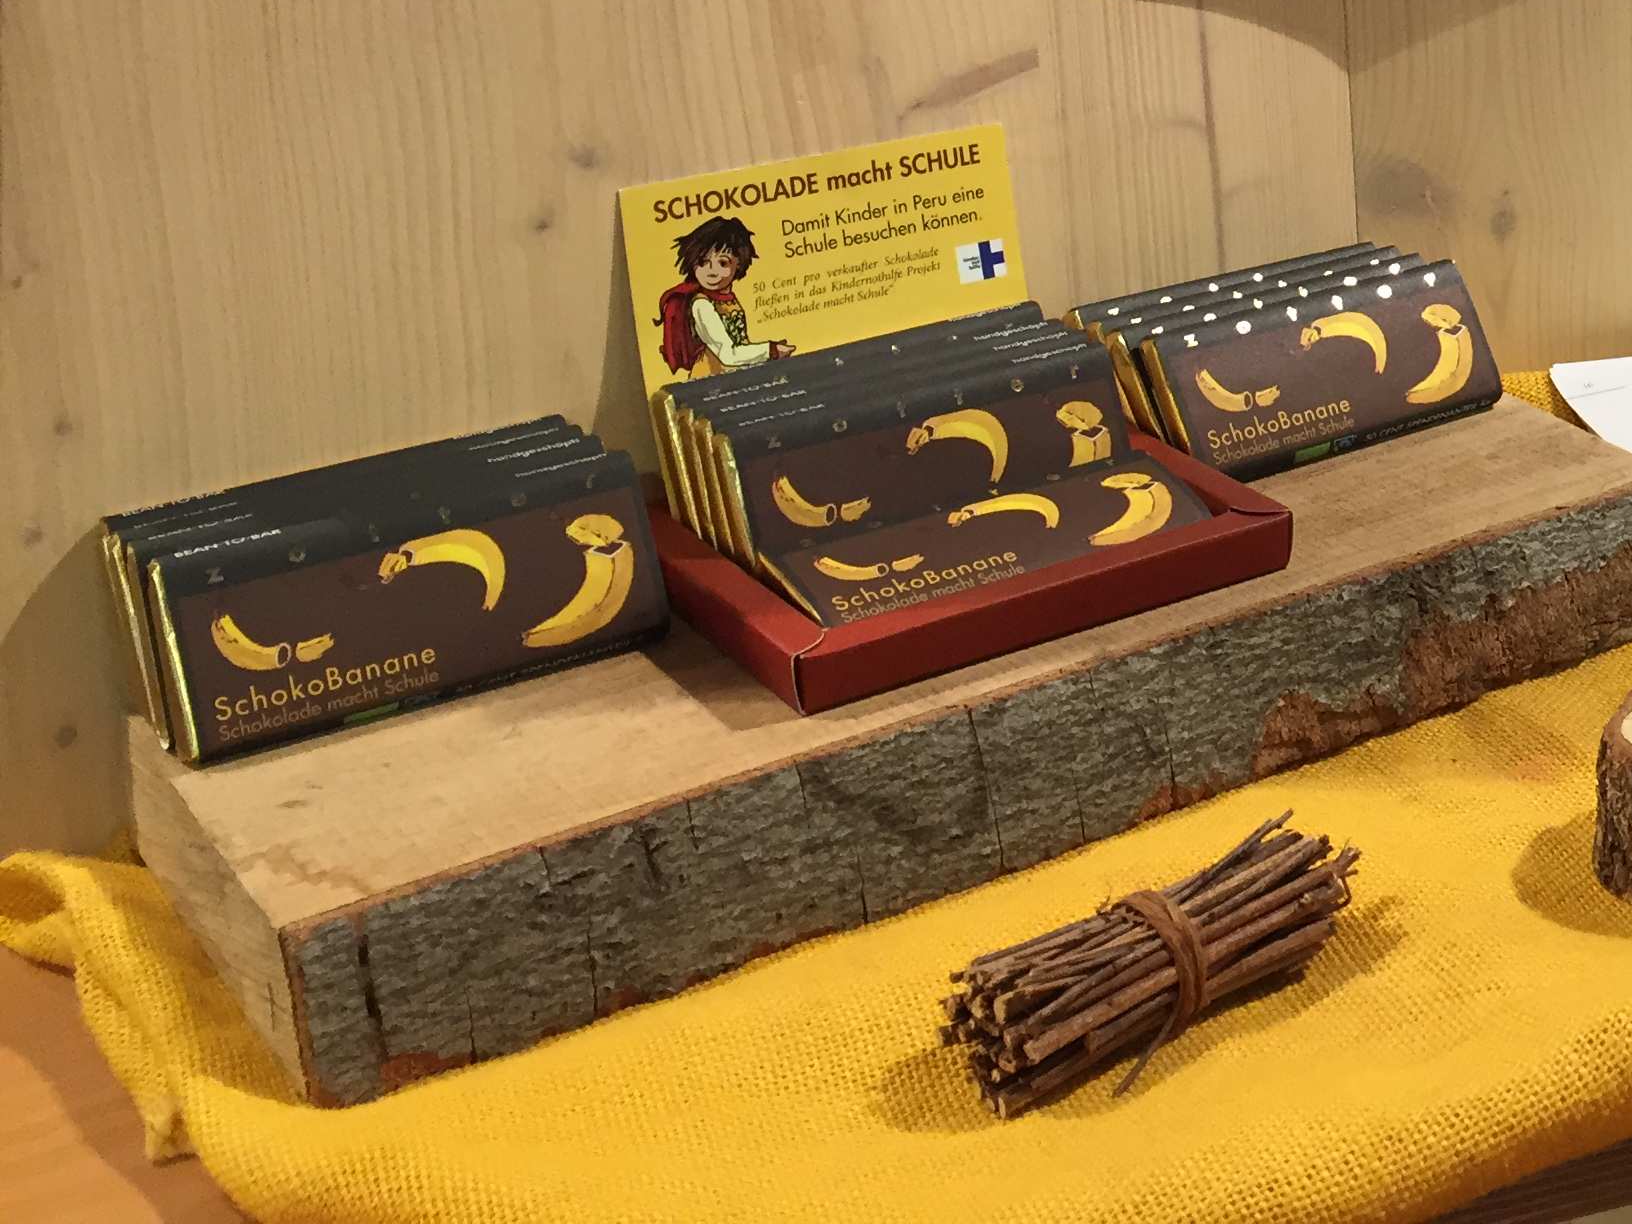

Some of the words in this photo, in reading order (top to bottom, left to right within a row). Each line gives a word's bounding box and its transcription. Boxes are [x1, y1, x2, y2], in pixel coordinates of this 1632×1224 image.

[653, 172, 819, 223] SCHOKOLADE
[826, 160, 893, 191] macht
[899, 143, 981, 177] SCHULE
[781, 213, 830, 237] Damit
[834, 202, 887, 226] Kinder
[894, 198, 908, 214] in
[913, 192, 947, 211] Peru
[952, 186, 985, 204] eine
[784, 234, 838, 258] Schule
[843, 218, 917, 248] besuchen
[752, 282, 766, 293] 50
[772, 277, 797, 290] Cent
[803, 272, 821, 286] pro
[827, 258, 879, 279] verkaufter
[884, 247, 940, 267] Schokolade
[754, 293, 790, 312] fließen
[794, 287, 806, 299] in
[809, 284, 827, 298] das
[831, 268, 904, 293] Kindernothilfe
[906, 262, 942, 280] Projekt
[823, 294, 855, 310] macht
[1207, 398, 1351, 450] SchokoBanane
[1214, 437, 1280, 466] Schokolade
[1283, 426, 1316, 446] macht
[1319, 416, 1355, 436] Schule
[831, 551, 1018, 612] SchokoBanane
[840, 592, 929, 623] Schokolade
[932, 578, 976, 598] macht
[978, 563, 1025, 585] Schule
[213, 647, 437, 721] SchokoBanane
[218, 701, 322, 743] Schokolade
[327, 685, 380, 711] macht
[383, 668, 440, 696] Schule
